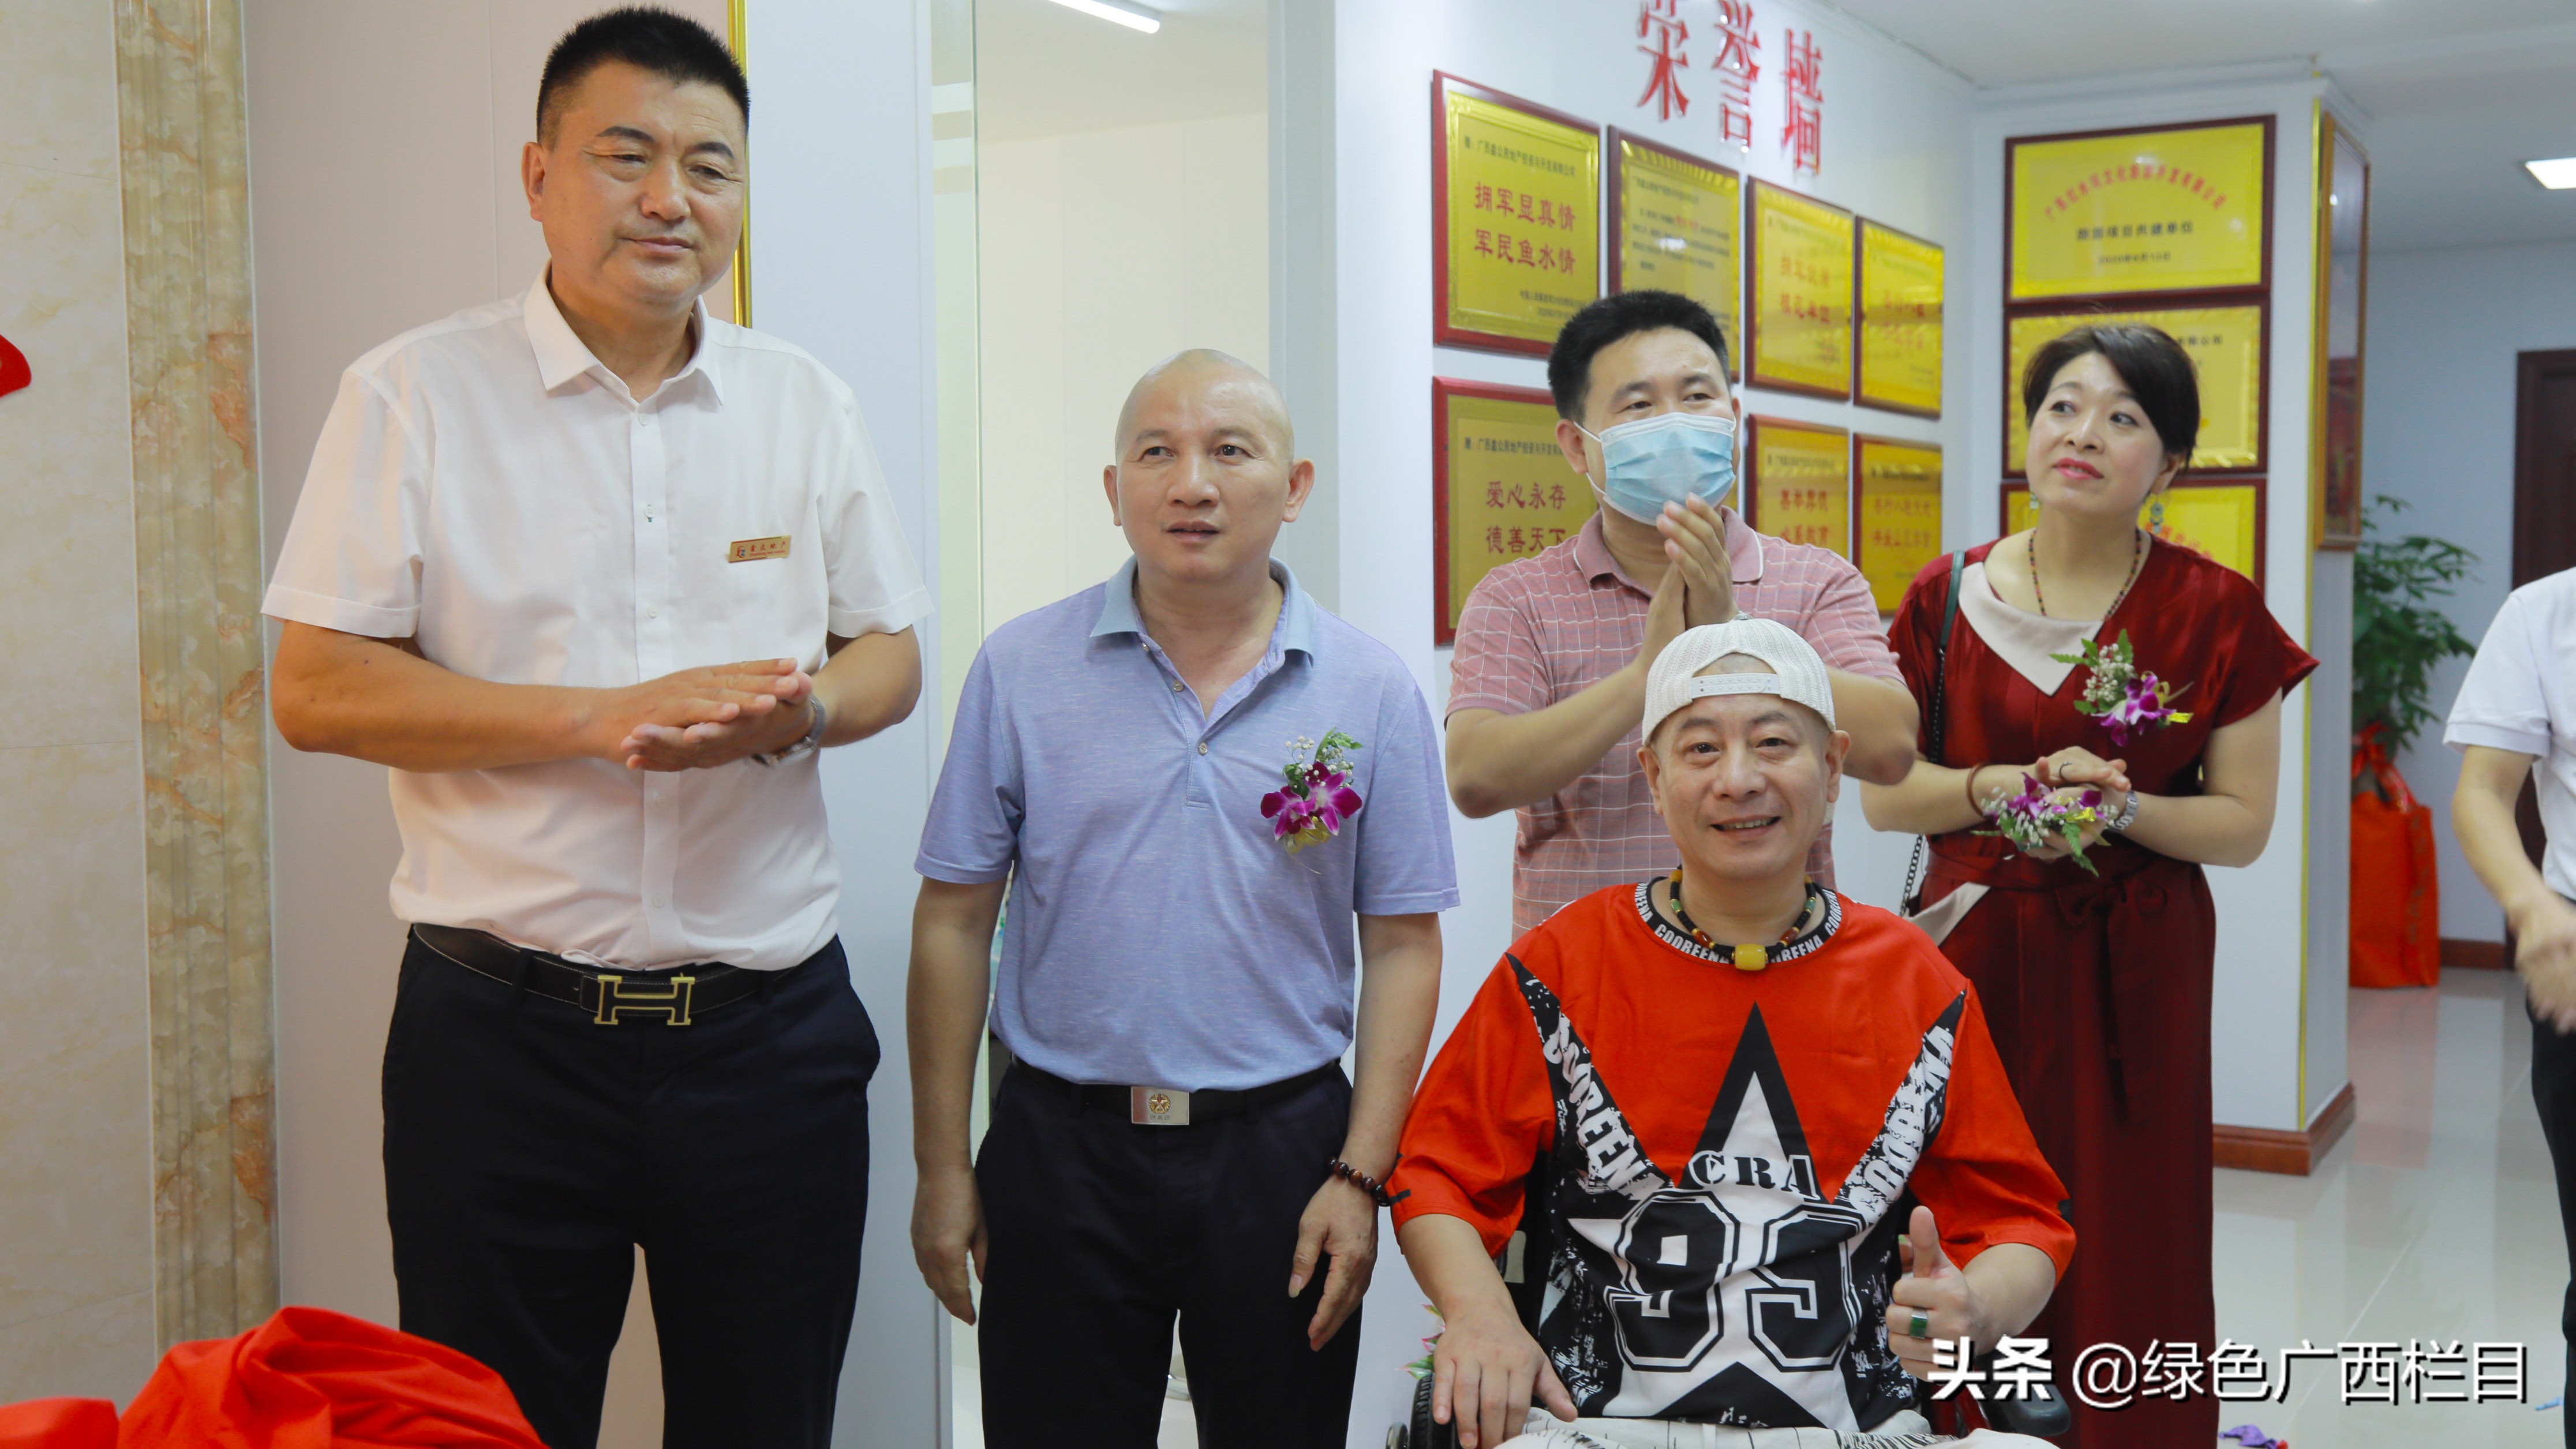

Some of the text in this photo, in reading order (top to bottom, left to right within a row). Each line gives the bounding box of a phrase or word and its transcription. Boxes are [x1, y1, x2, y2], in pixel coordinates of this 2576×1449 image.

[1474, 181, 1576, 231] 拥军显真情
[1474, 229, 1576, 275] 军民鱼水情
[1486, 481, 1567, 511] 爱心永存
[1688, 1150, 1821, 1200] CRA
